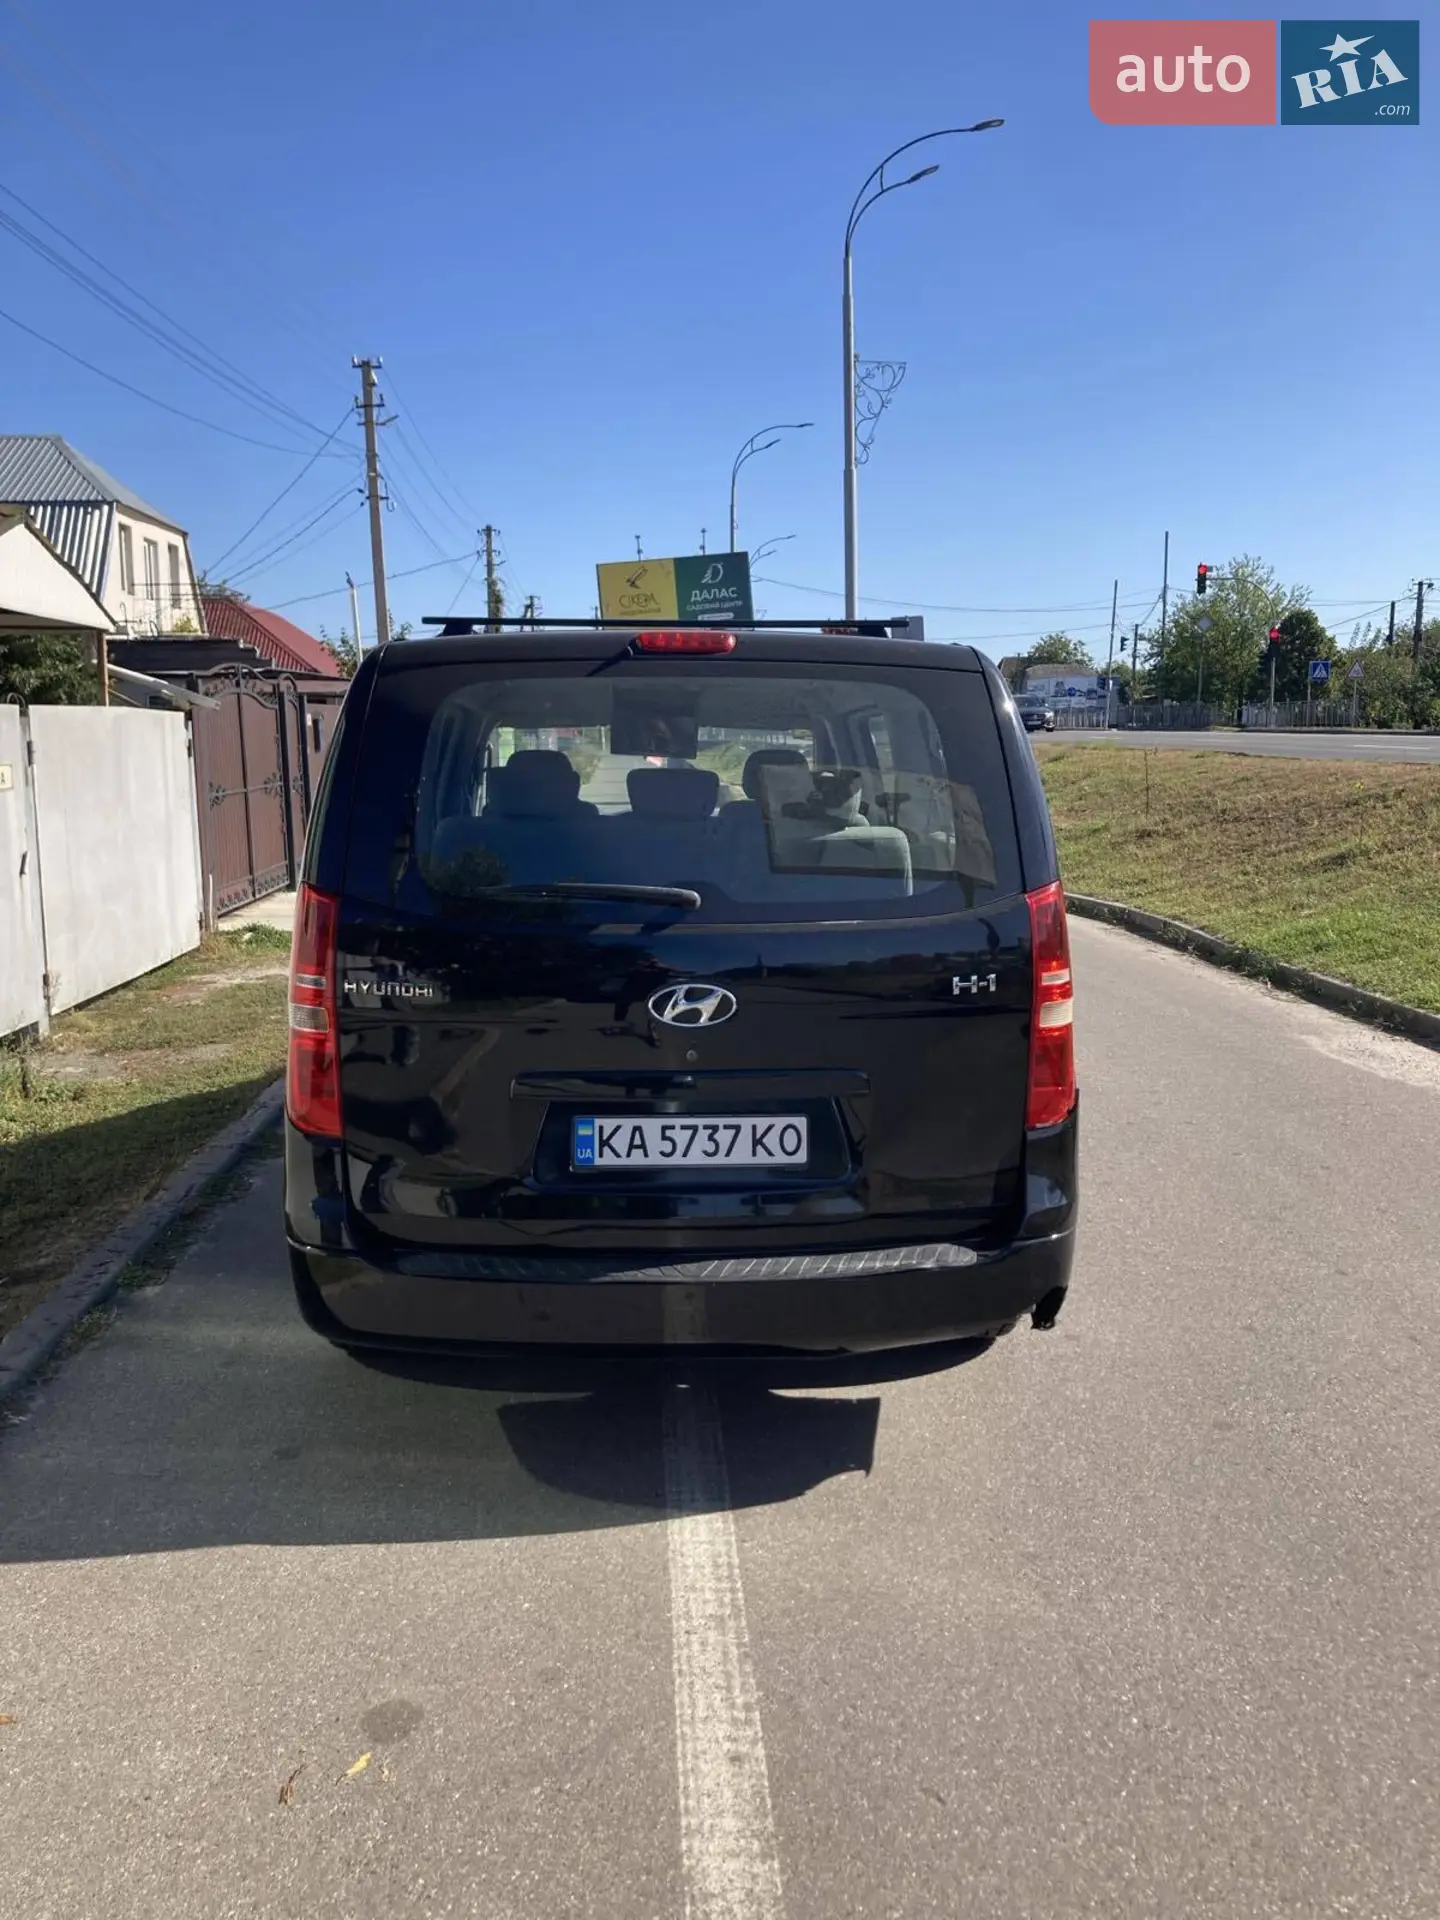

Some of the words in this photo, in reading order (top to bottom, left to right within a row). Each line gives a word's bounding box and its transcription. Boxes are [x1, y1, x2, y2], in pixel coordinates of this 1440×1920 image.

[691, 587, 738, 602] ДАЛАС
[344, 981, 433, 998] HYUNDAI
[952, 973, 997, 996] H-1
[598, 1124, 649, 1159] KA
[658, 1124, 742, 1158] 5737
[751, 1123, 802, 1157] KO
[577, 1148, 594, 1159] UA
